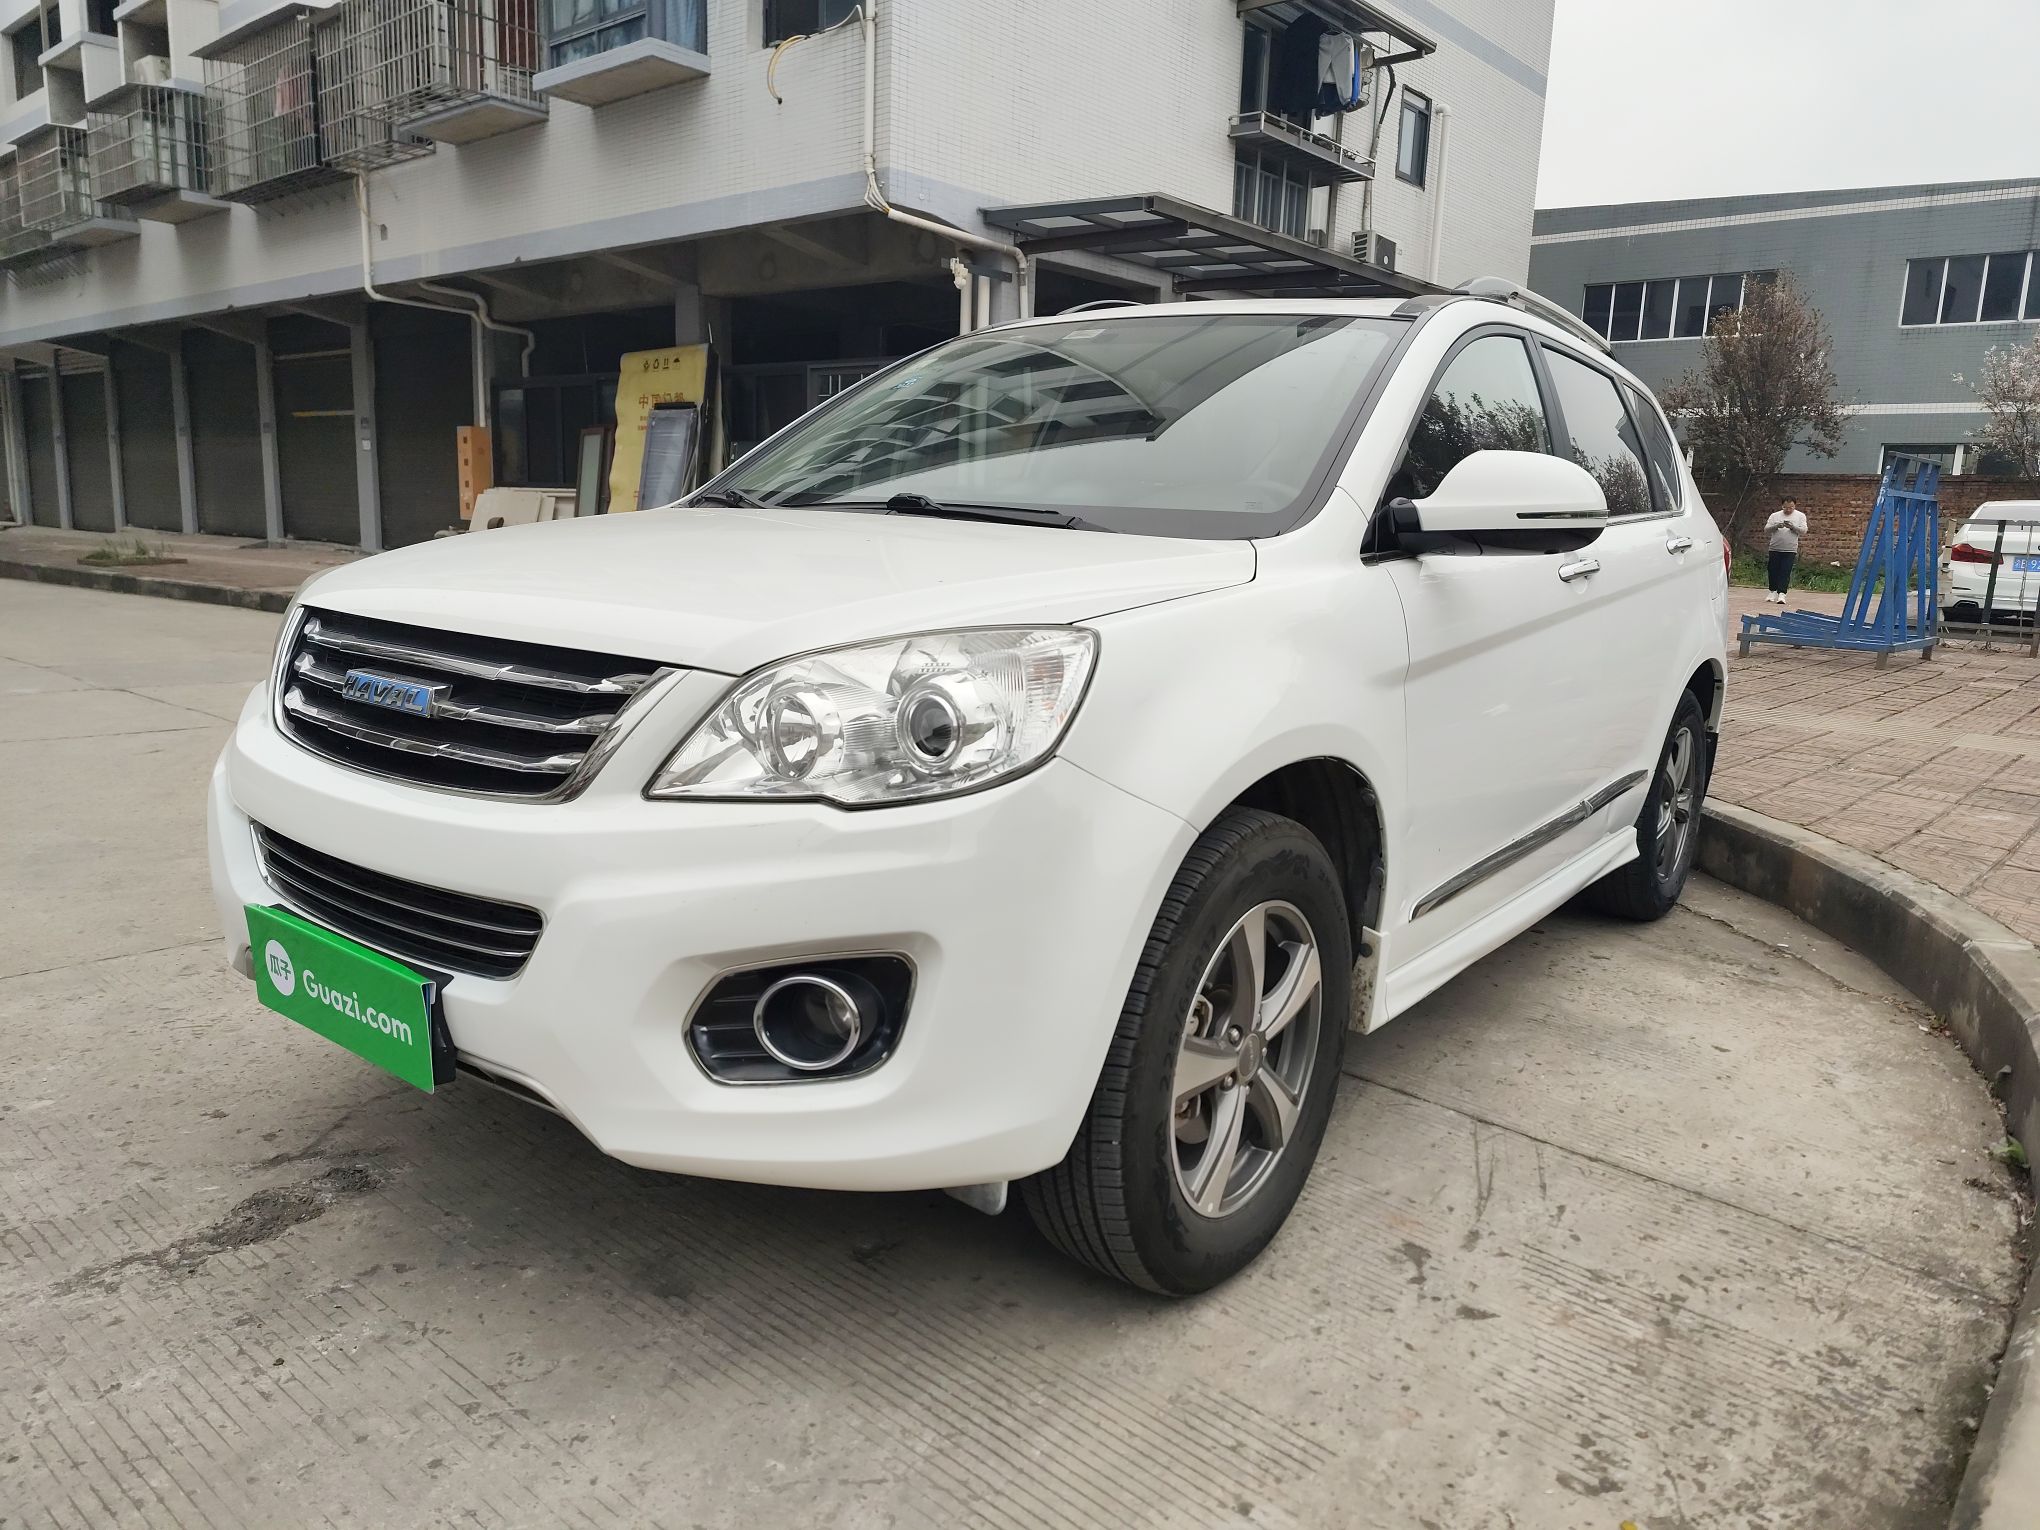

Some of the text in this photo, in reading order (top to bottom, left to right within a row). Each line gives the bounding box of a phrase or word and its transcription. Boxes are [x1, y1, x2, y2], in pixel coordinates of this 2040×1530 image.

[343, 675, 424, 712] HAVAL
[269, 953, 292, 981] 瓜子
[302, 969, 413, 1046] Guazi.com
